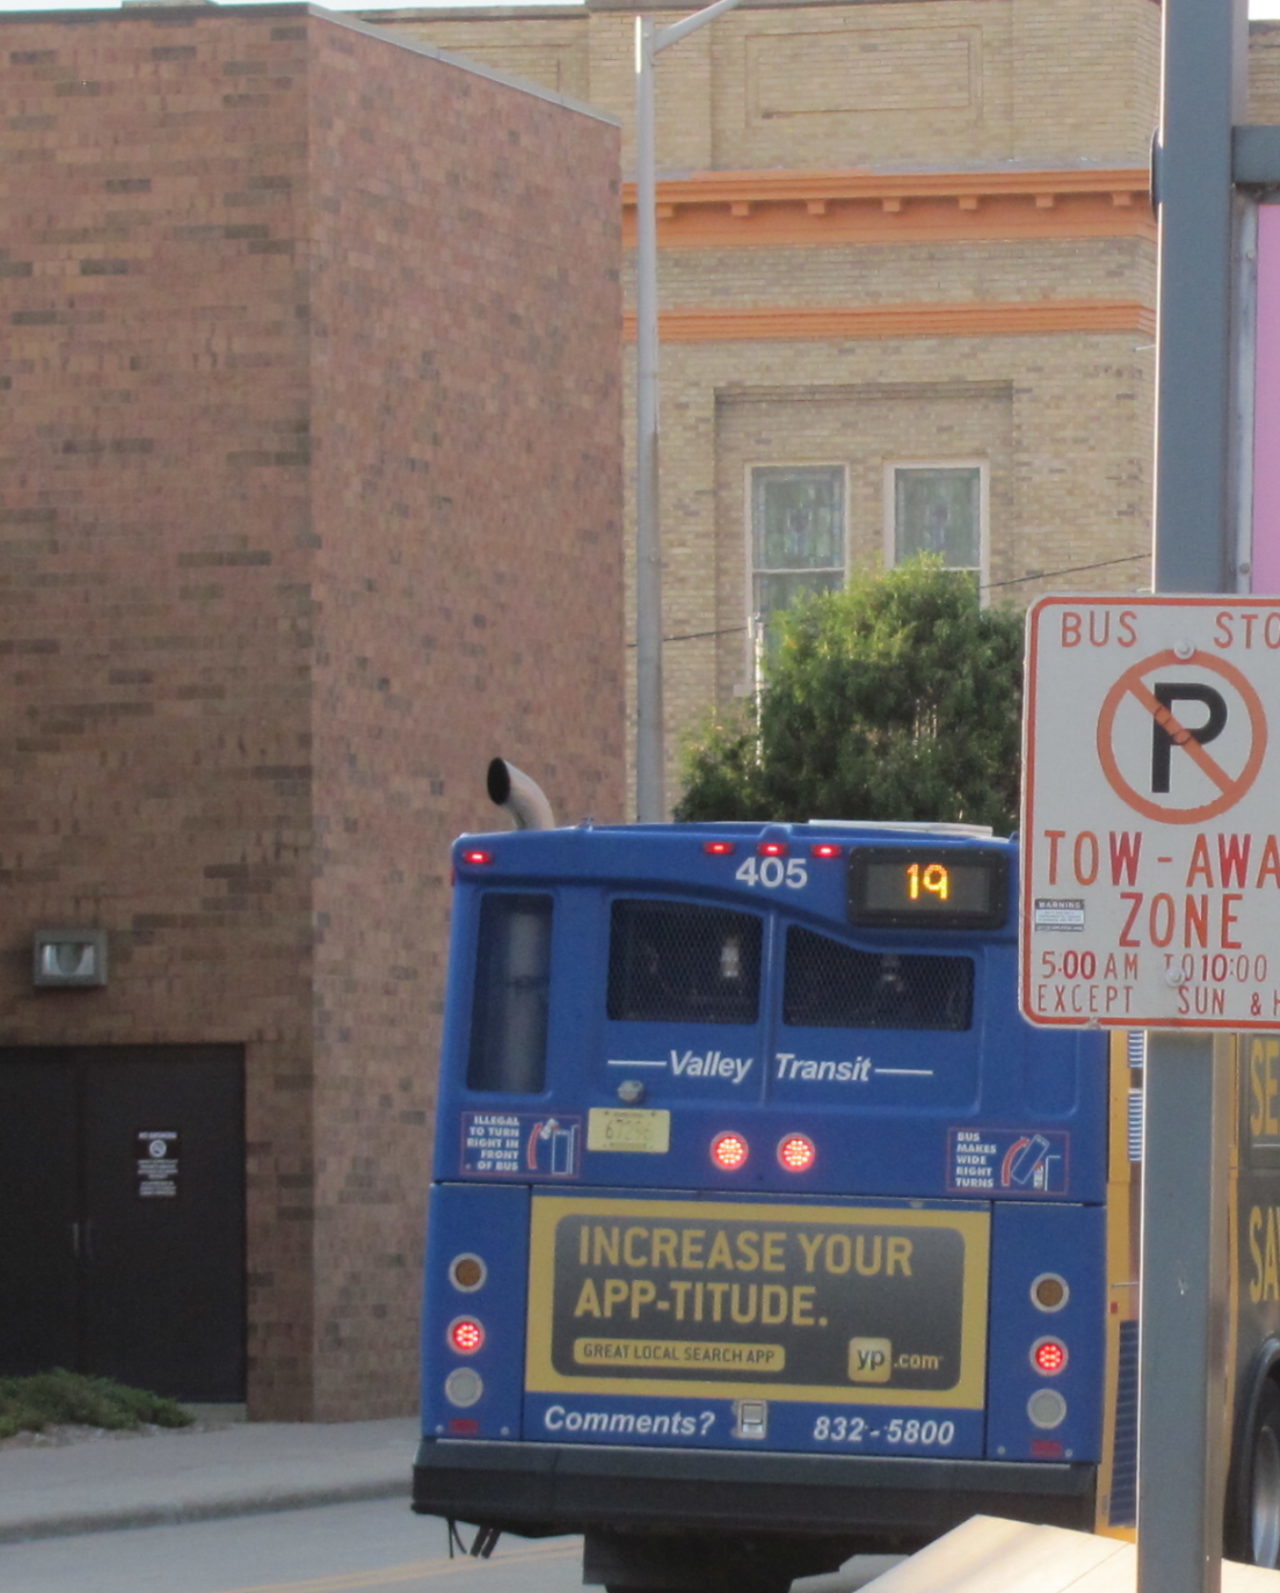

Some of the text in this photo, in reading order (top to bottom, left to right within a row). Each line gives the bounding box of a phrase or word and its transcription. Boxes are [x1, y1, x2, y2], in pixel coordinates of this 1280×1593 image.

[1061, 610, 1138, 648] BUS
[1151, 682, 1228, 793] P
[735, 857, 808, 889] 405
[906, 863, 949, 900] 19
[1118, 891, 1244, 950] ZONE
[1042, 950, 1096, 980] 5:00
[1104, 952, 1139, 981] AM
[1163, 953, 1195, 982] TO
[1201, 954, 1268, 983] 10:00
[1037, 983, 1134, 1014] EXCEPT
[1177, 985, 1226, 1016] SUN
[1250, 991, 1262, 1017] &
[669, 1050, 872, 1084] Valley Transit
[470, 1127, 520, 1137] TO TURN
[473, 1115, 520, 1126] ILLEGAL
[467, 1138, 520, 1149] RIGHT IN
[957, 1132, 980, 1142] BUS
[957, 1143, 997, 1154] MAKES
[476, 1161, 519, 1171] OF BUS
[480, 1150, 520, 1160] FRONT
[956, 1155, 987, 1165] WIDE
[955, 1166, 992, 1176] RIGHT
[955, 1178, 995, 1188] TURNS
[578, 1225, 914, 1277] INCREASE YOUR
[573, 1278, 829, 1326] APP-TITUDE.
[583, 1344, 775, 1364] GREAT LOCAL SEARCH APP
[544, 1405, 715, 1436] Comments?
